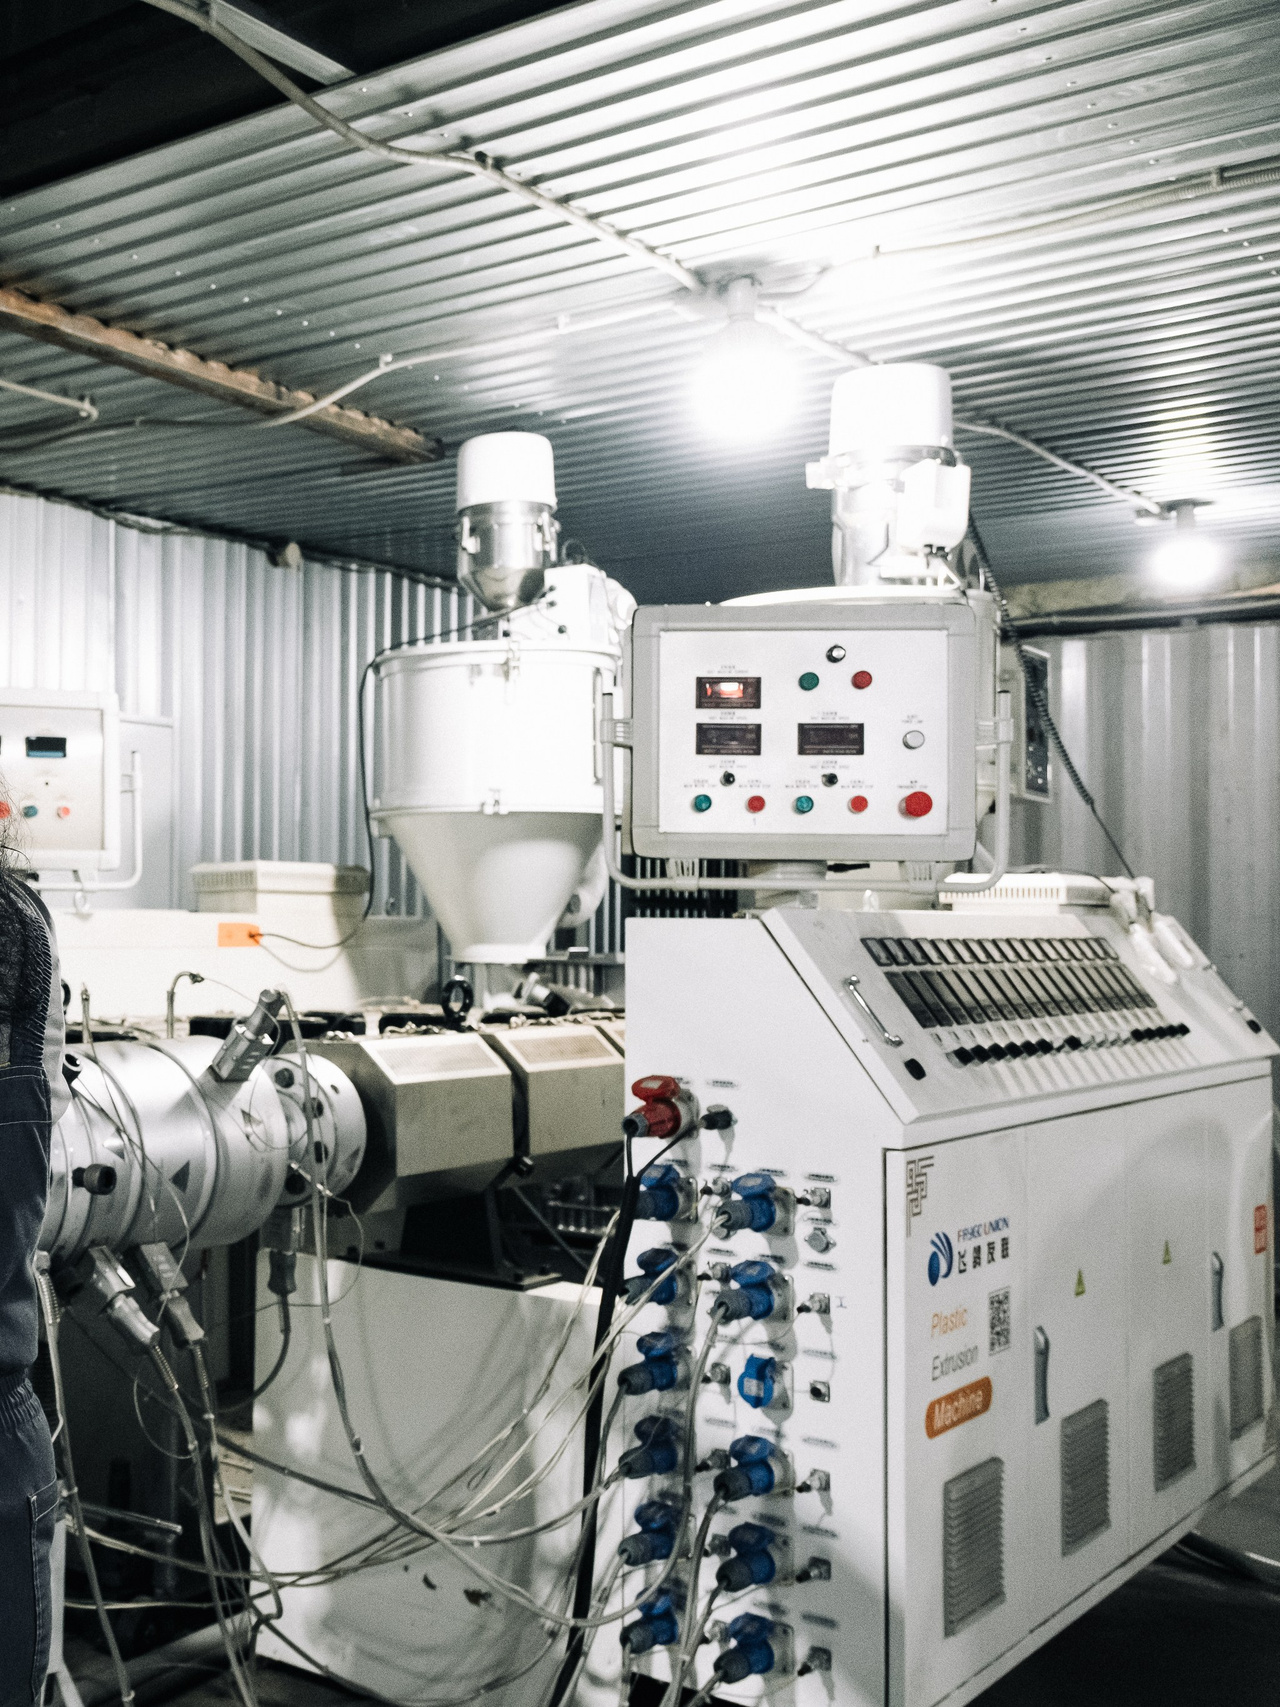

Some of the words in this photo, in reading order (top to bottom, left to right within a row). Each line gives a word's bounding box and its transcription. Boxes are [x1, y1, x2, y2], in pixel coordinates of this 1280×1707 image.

[931, 1304, 968, 1337] Plastic
[931, 1344, 979, 1381] Extrusion
[933, 1390, 983, 1430] Machine
